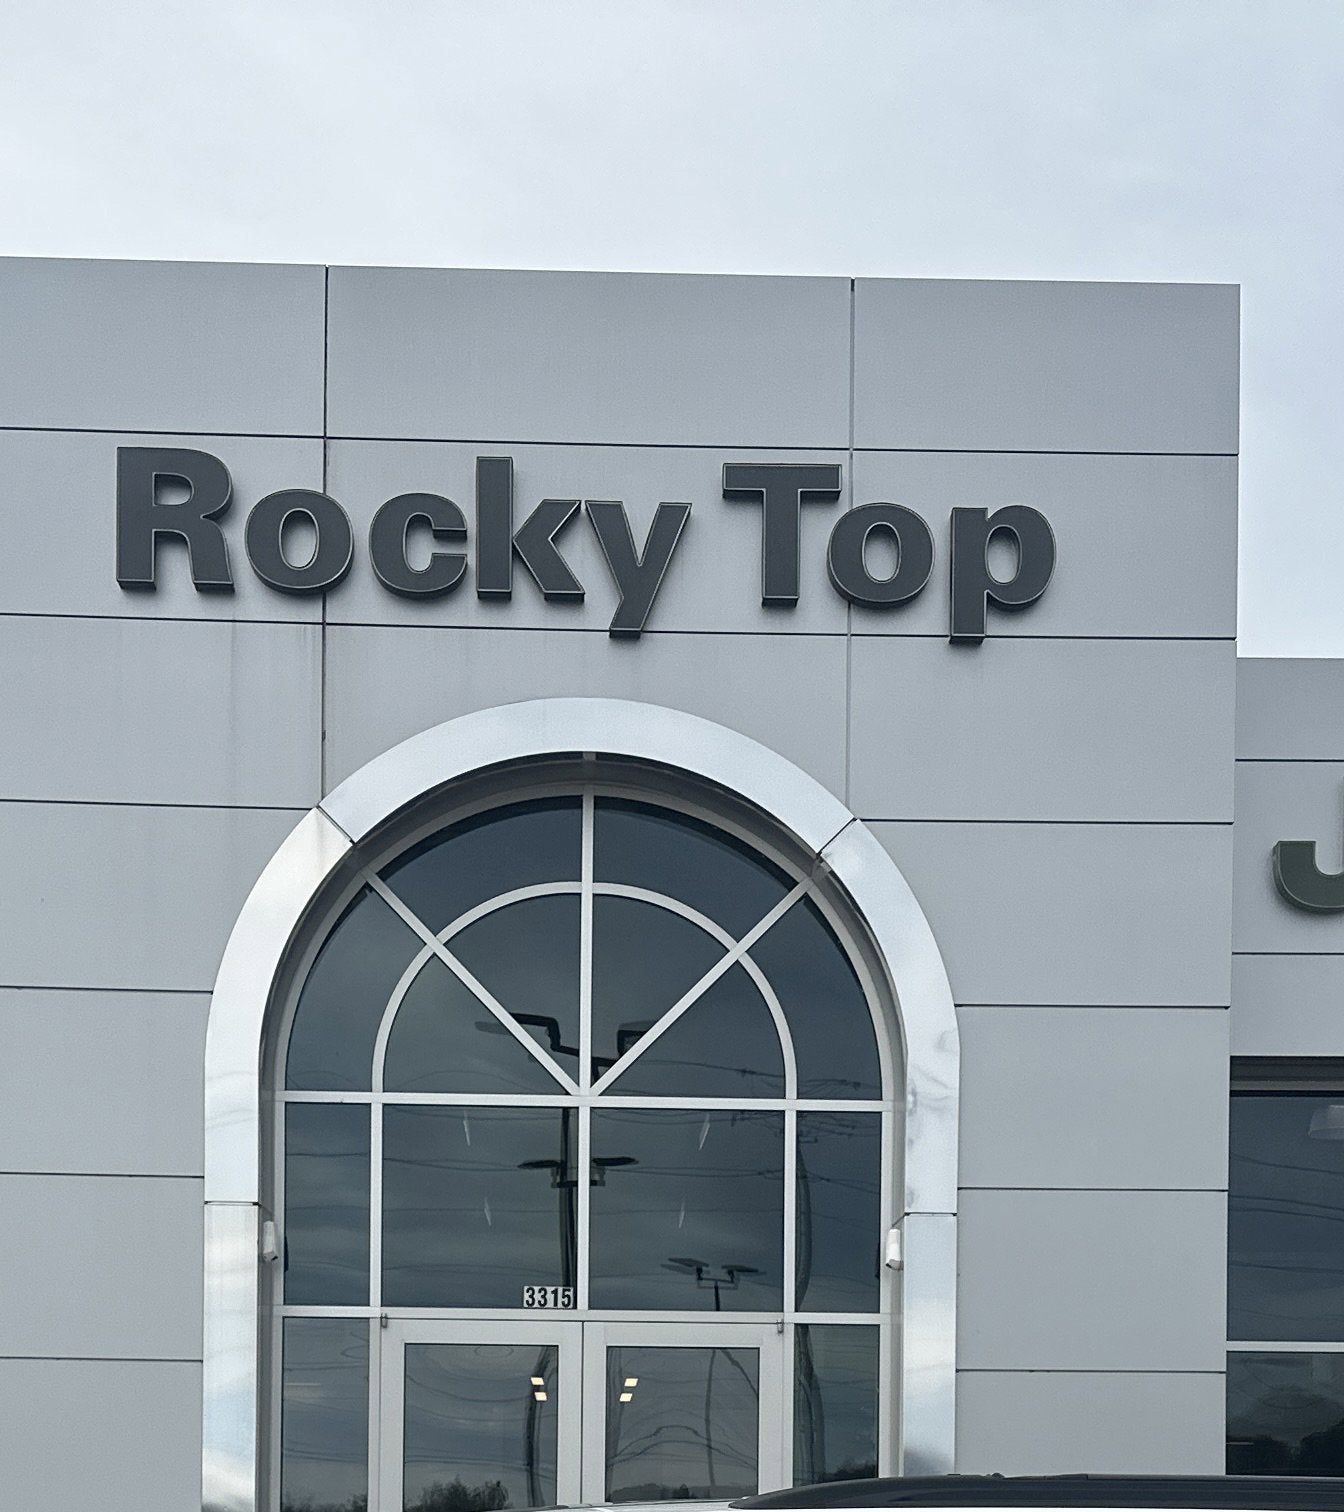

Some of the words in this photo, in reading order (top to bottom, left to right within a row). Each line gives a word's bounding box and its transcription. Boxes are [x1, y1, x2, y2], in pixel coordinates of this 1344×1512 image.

[115, 446, 693, 638] Rocky
[722, 462, 1058, 644] Top
[525, 1286, 572, 1308] 3315
